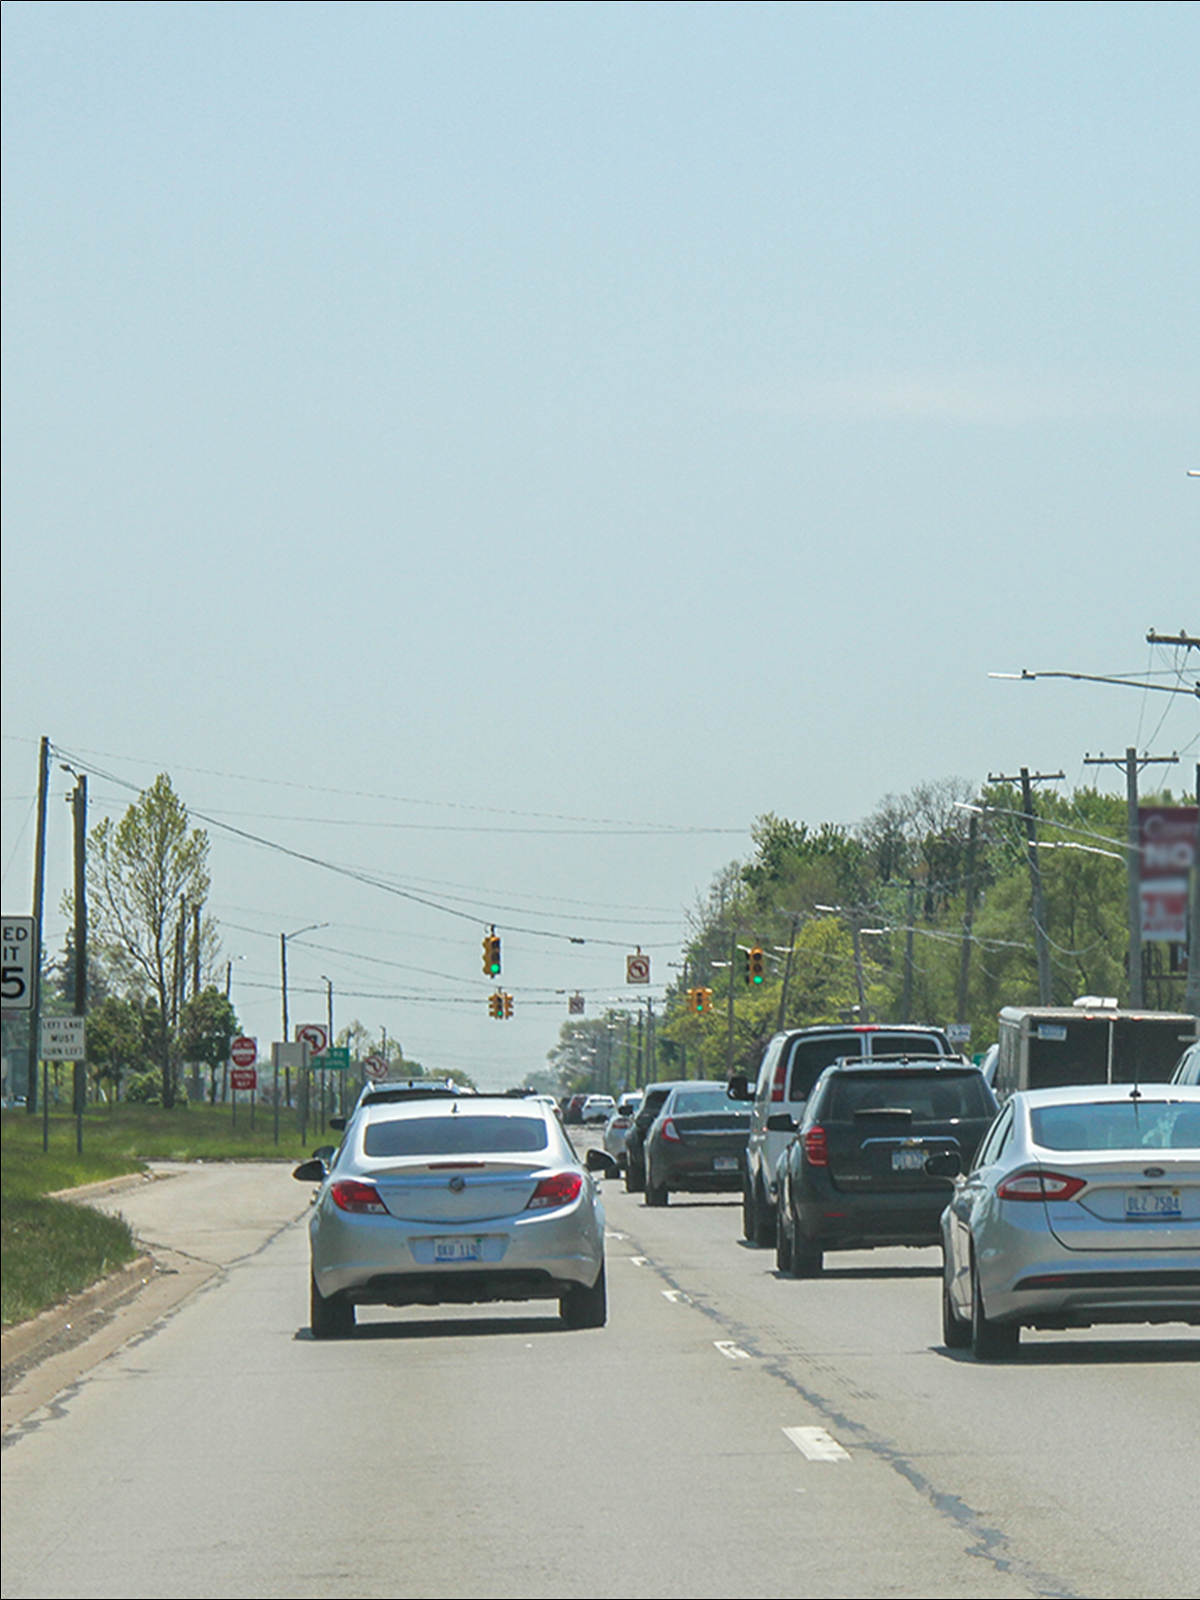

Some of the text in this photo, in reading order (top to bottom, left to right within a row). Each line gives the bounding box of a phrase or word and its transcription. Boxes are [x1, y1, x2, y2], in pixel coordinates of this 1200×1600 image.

[43, 1021, 83, 1030] LEFT LANE
[51, 1034, 75, 1043] MUST
[43, 1047, 83, 1056] TURN LEFT
